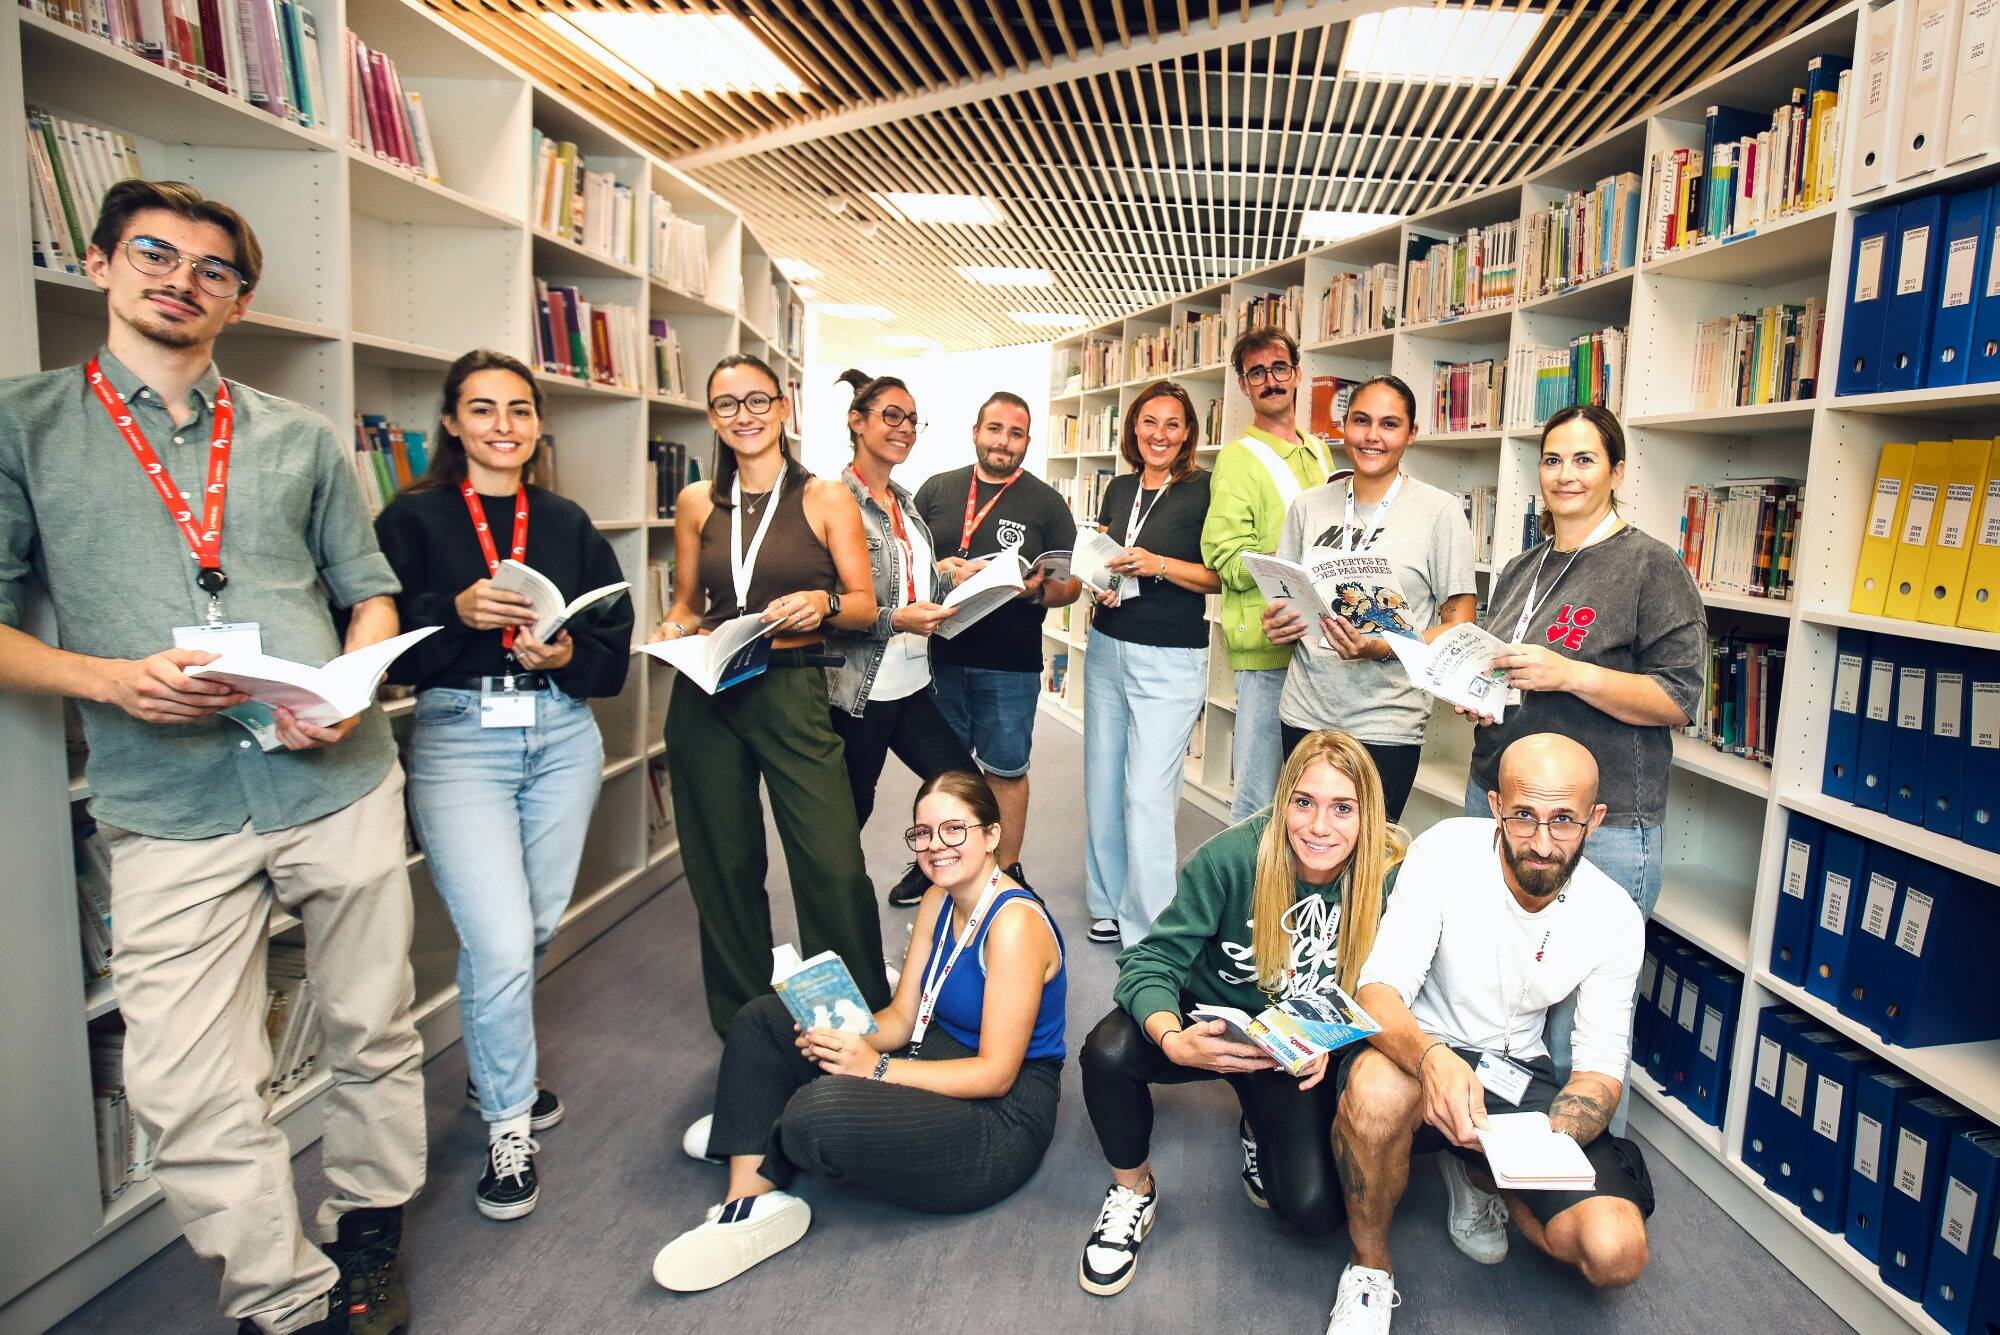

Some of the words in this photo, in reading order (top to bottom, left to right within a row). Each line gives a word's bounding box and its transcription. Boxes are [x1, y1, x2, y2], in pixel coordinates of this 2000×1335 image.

[1972, 43, 1985, 51] 2023
[1971, 50, 1984, 59] 2024
[1656, 155, 1674, 254] Recherches
[1951, 244, 1975, 253] LIBERALE
[1311, 561, 1333, 574] DES
[1334, 557, 1373, 567] VERTES
[1375, 558, 1388, 567] ET
[1338, 567, 1358, 575] PAS
[1830, 874, 1848, 883] MEDECINE
[1873, 874, 1895, 886] MEDECINE
[1909, 889, 1932, 902] MEDECINE
[1764, 1039, 1777, 1049] SOINS
[1791, 1057, 1803, 1067] SOINS
[1823, 1079, 1839, 1090] SOINS
[1863, 1117, 1877, 1127] SOINS
[1905, 1132, 1921, 1145] SOINS
[1955, 1182, 1972, 1196] SOINS
